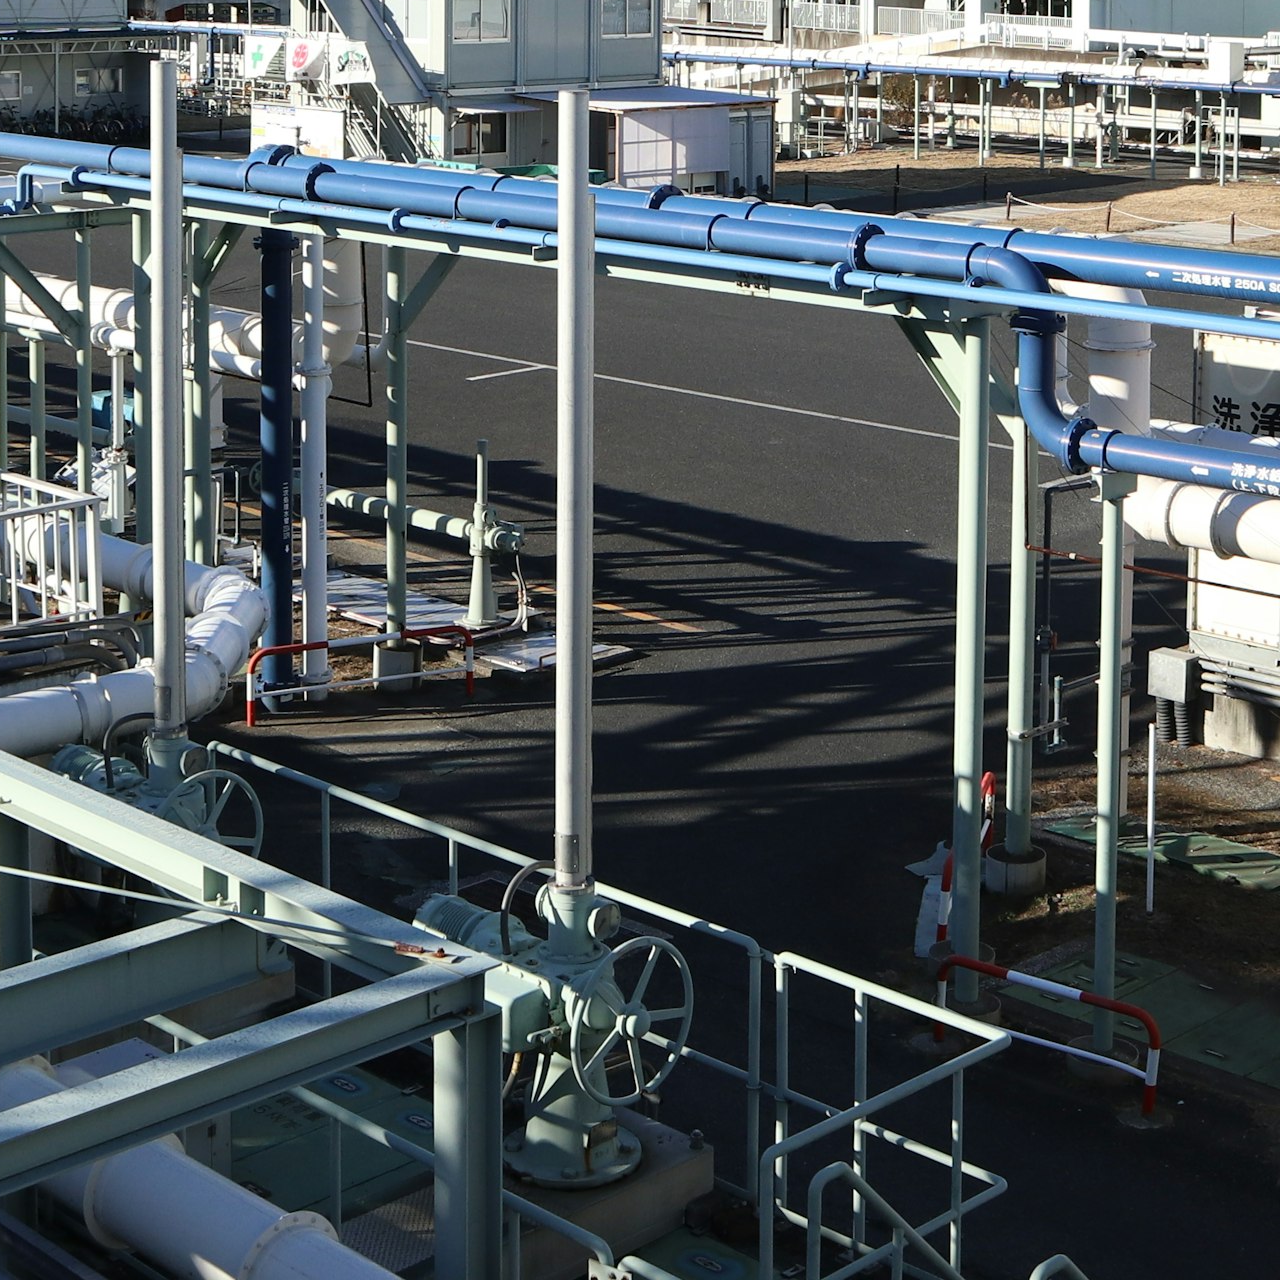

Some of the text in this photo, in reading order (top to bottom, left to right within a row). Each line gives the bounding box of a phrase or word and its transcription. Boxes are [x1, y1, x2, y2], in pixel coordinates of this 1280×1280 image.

[1172, 271, 1231, 290] 二次処理水管
[1234, 279, 1266, 293] 250A
